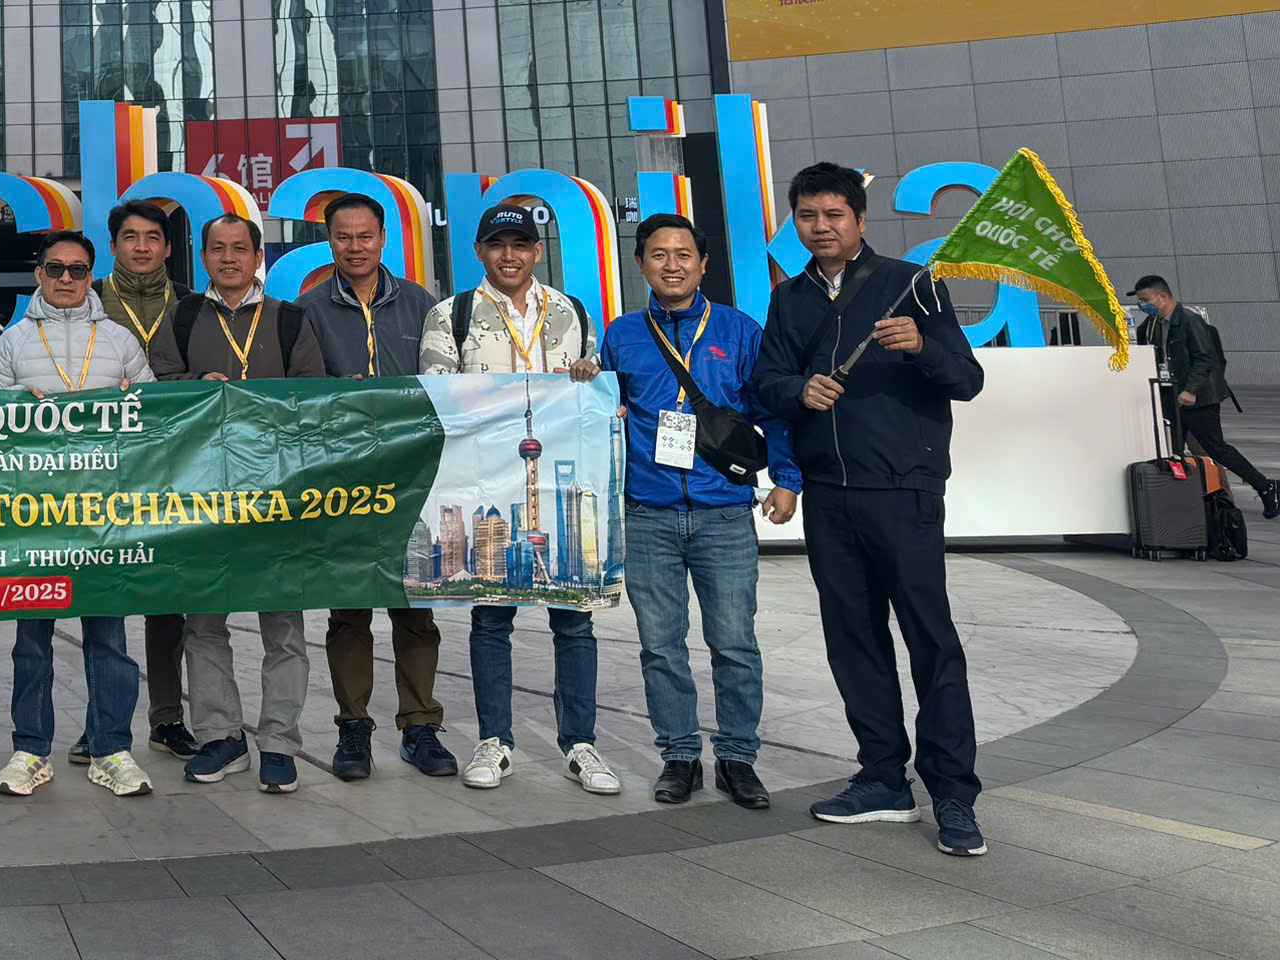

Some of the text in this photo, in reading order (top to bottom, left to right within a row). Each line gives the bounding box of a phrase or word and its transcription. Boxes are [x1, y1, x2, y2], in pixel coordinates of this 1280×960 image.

[496, 211, 523, 220] AUTO
[92, 389, 144, 434] TẾ
[28, 453, 65, 477] ĐẠI
[69, 444, 119, 471] BIỂU
[299, 482, 396, 520] 2025
[25, 547, 115, 572] THƯỢNG
[118, 541, 155, 565] HẢI
